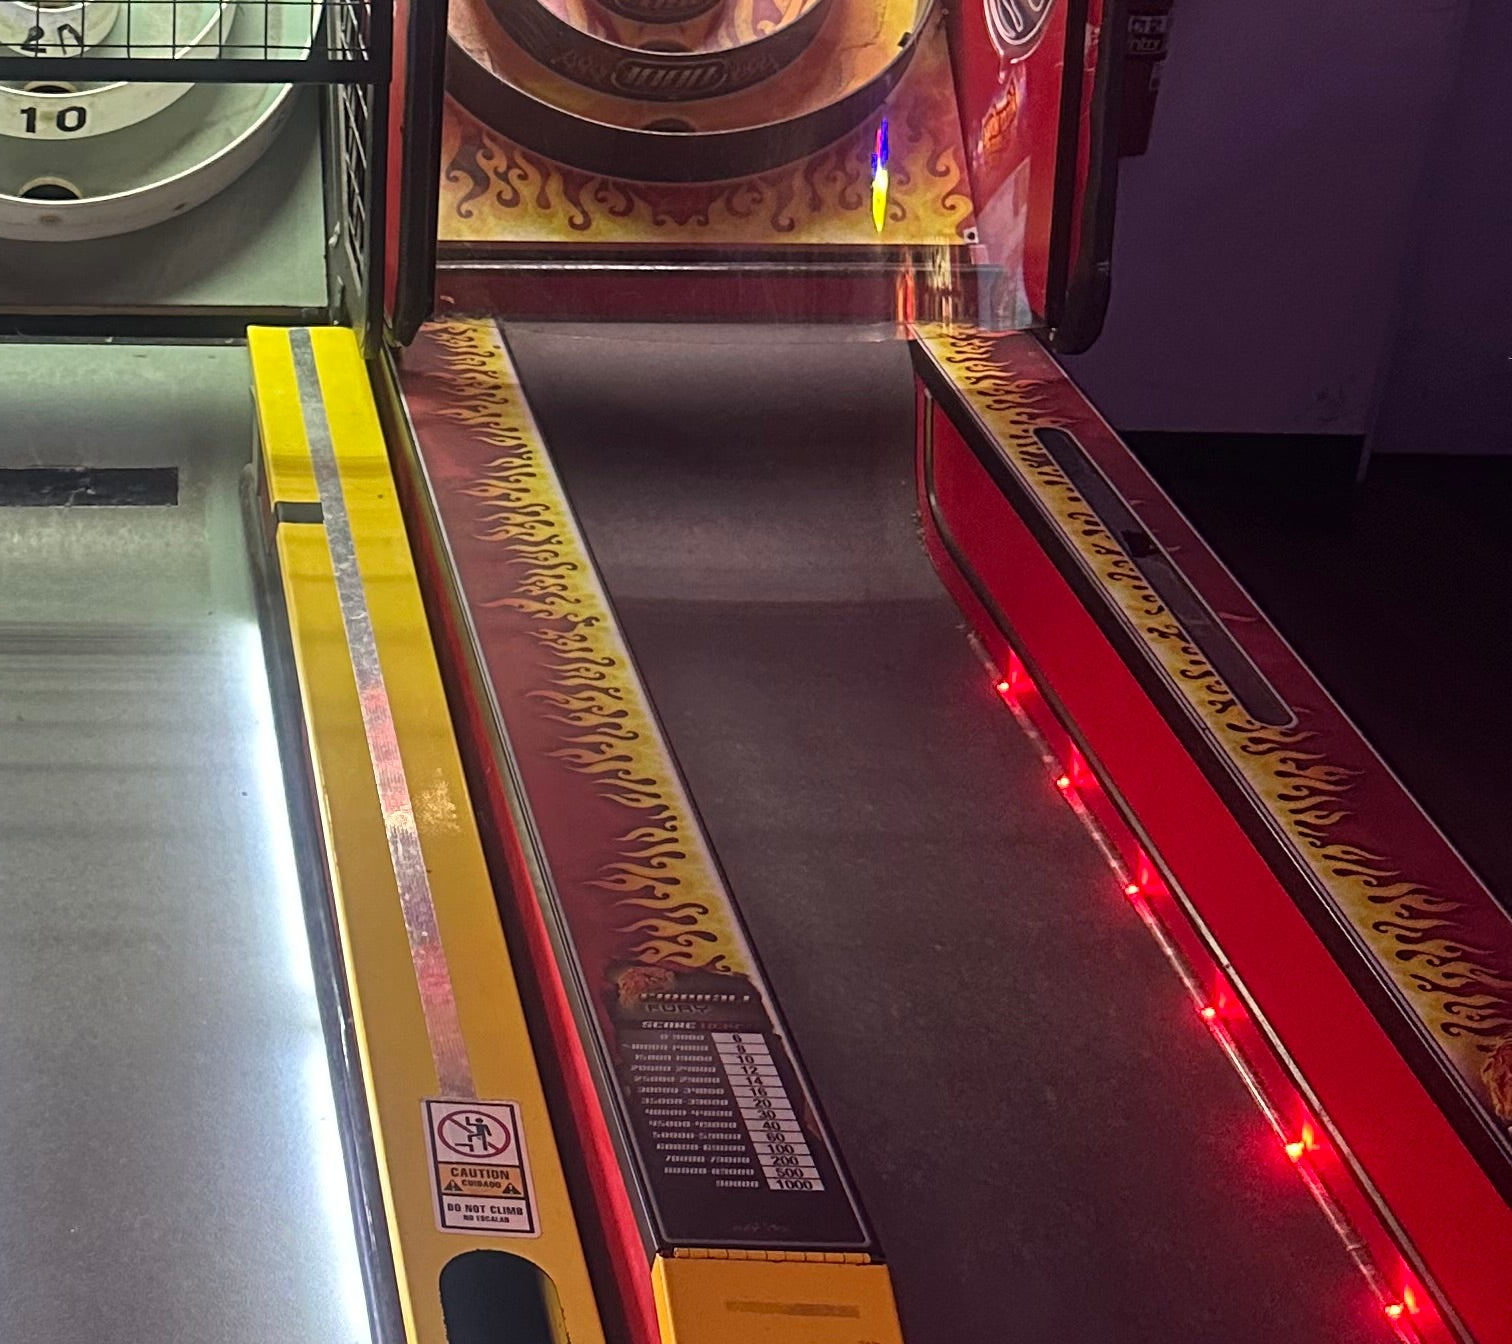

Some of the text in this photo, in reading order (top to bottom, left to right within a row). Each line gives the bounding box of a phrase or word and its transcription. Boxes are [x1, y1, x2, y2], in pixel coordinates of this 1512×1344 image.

[19, 105, 88, 135] 10
[737, 1055, 755, 1064] 10
[741, 1065, 758, 1075] 12
[746, 1076, 763, 1086] 14
[750, 1087, 768, 1097] 16
[753, 1098, 772, 1108] 20
[757, 1109, 777, 1120] 30
[763, 1121, 781, 1131] 40
[768, 1144, 795, 1154] 100
[770, 1156, 799, 1166] 200
[450, 1167, 510, 1181] CAUTION
[775, 1167, 804, 1178] 500
[461, 1179, 502, 1189] CUIDADO
[776, 1180, 814, 1190] 1000
[447, 1203, 524, 1216] DO NOT CLIMB
